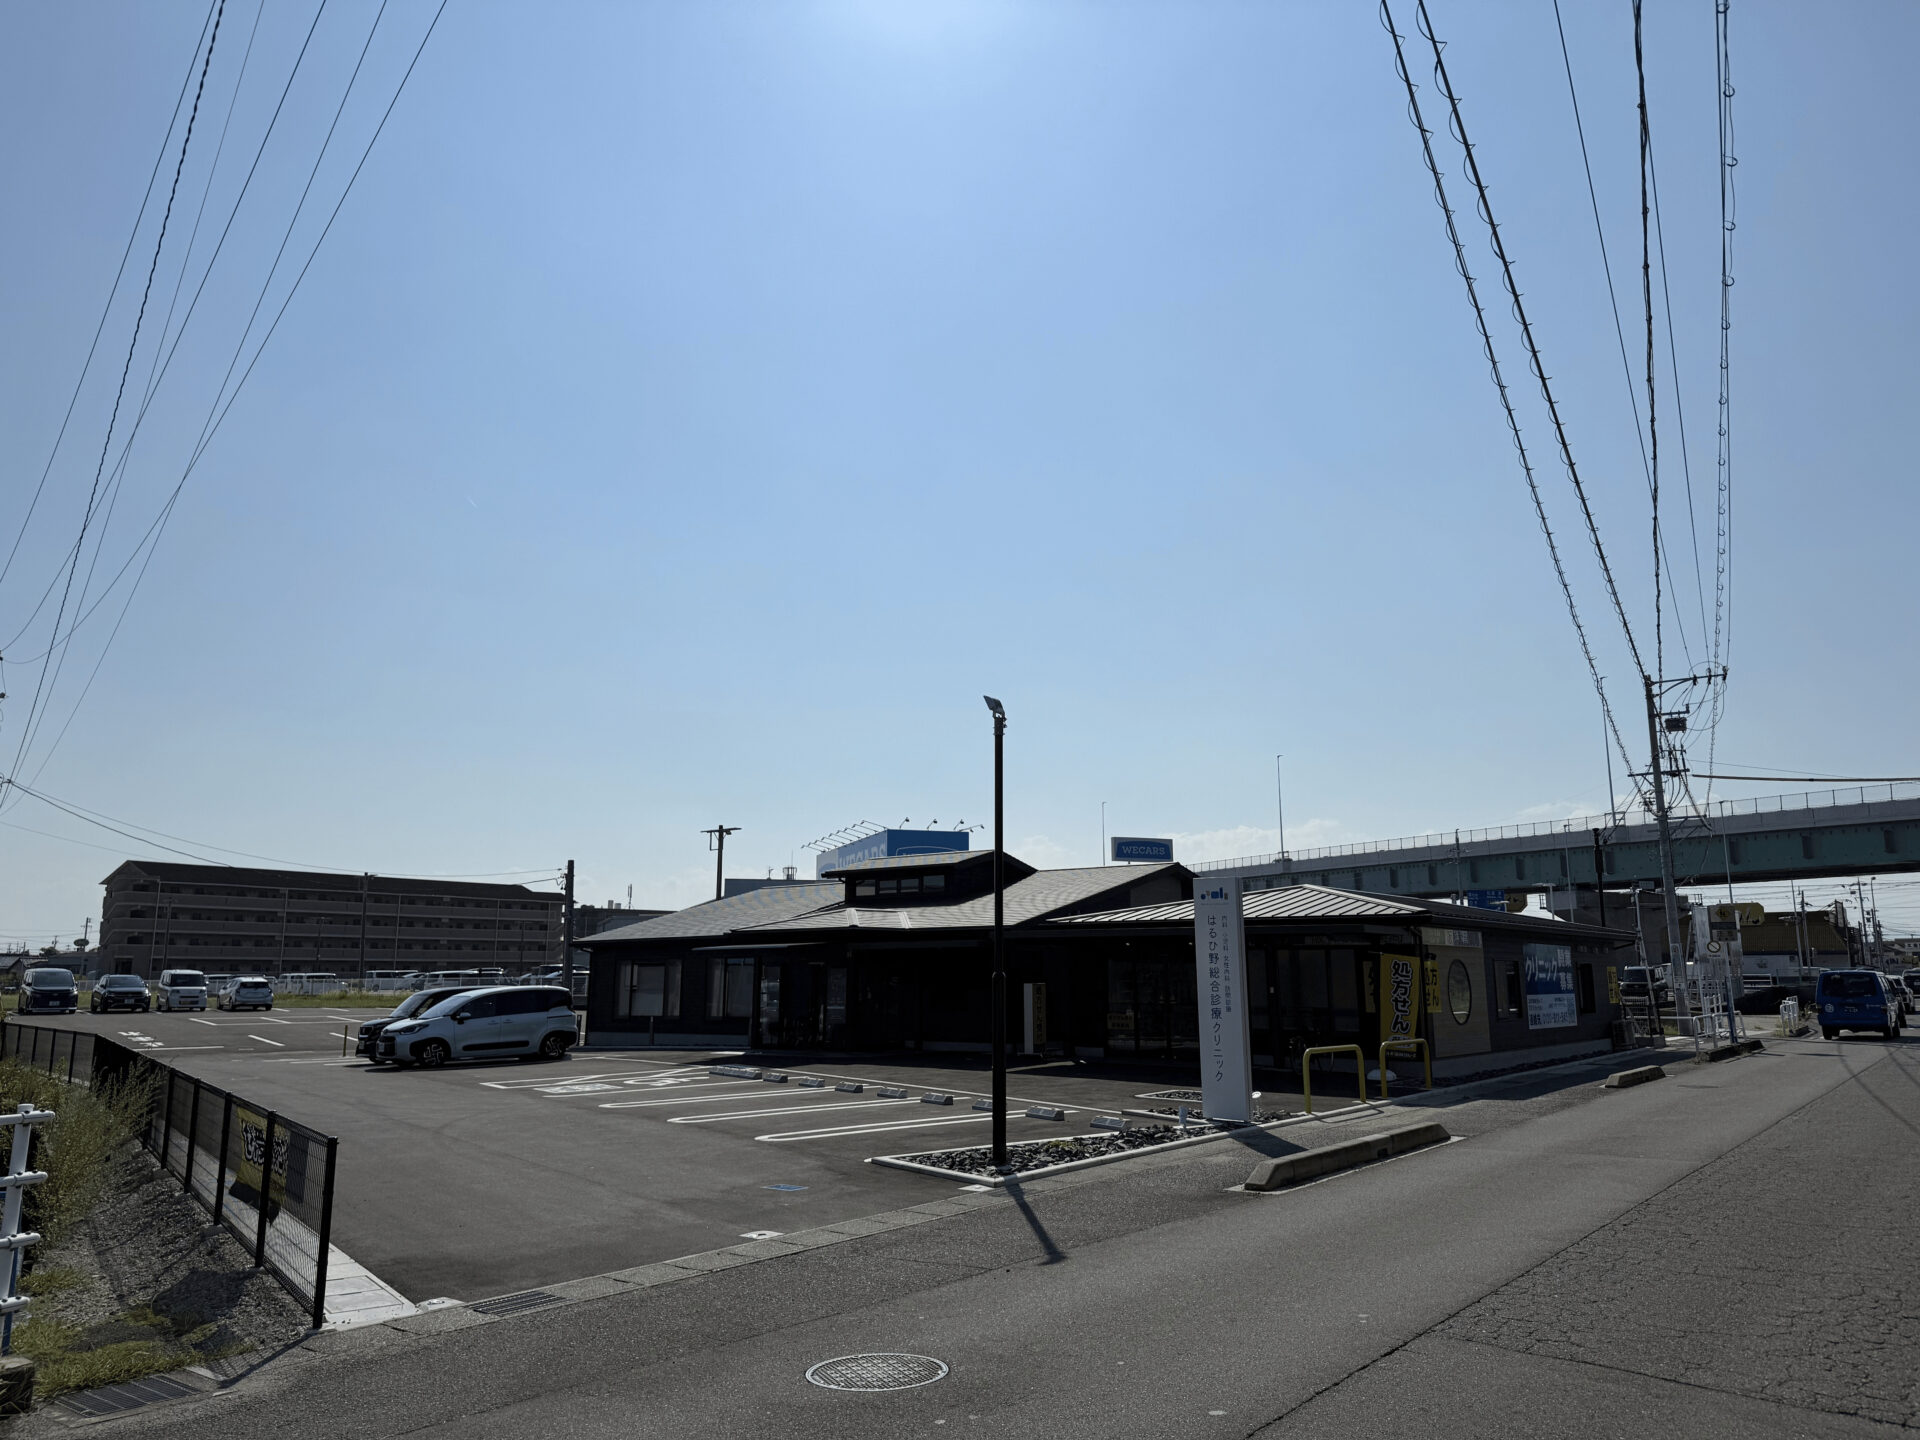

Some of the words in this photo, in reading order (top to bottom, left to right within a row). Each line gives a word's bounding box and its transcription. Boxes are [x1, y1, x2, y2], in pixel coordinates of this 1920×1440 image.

[1121, 845, 1166, 855] WECARS
[1525, 955, 1559, 982] クリニック
[1207, 915, 1225, 1082] はるひ野総合診療クリニック
[1391, 960, 1412, 1034] 処方せん
